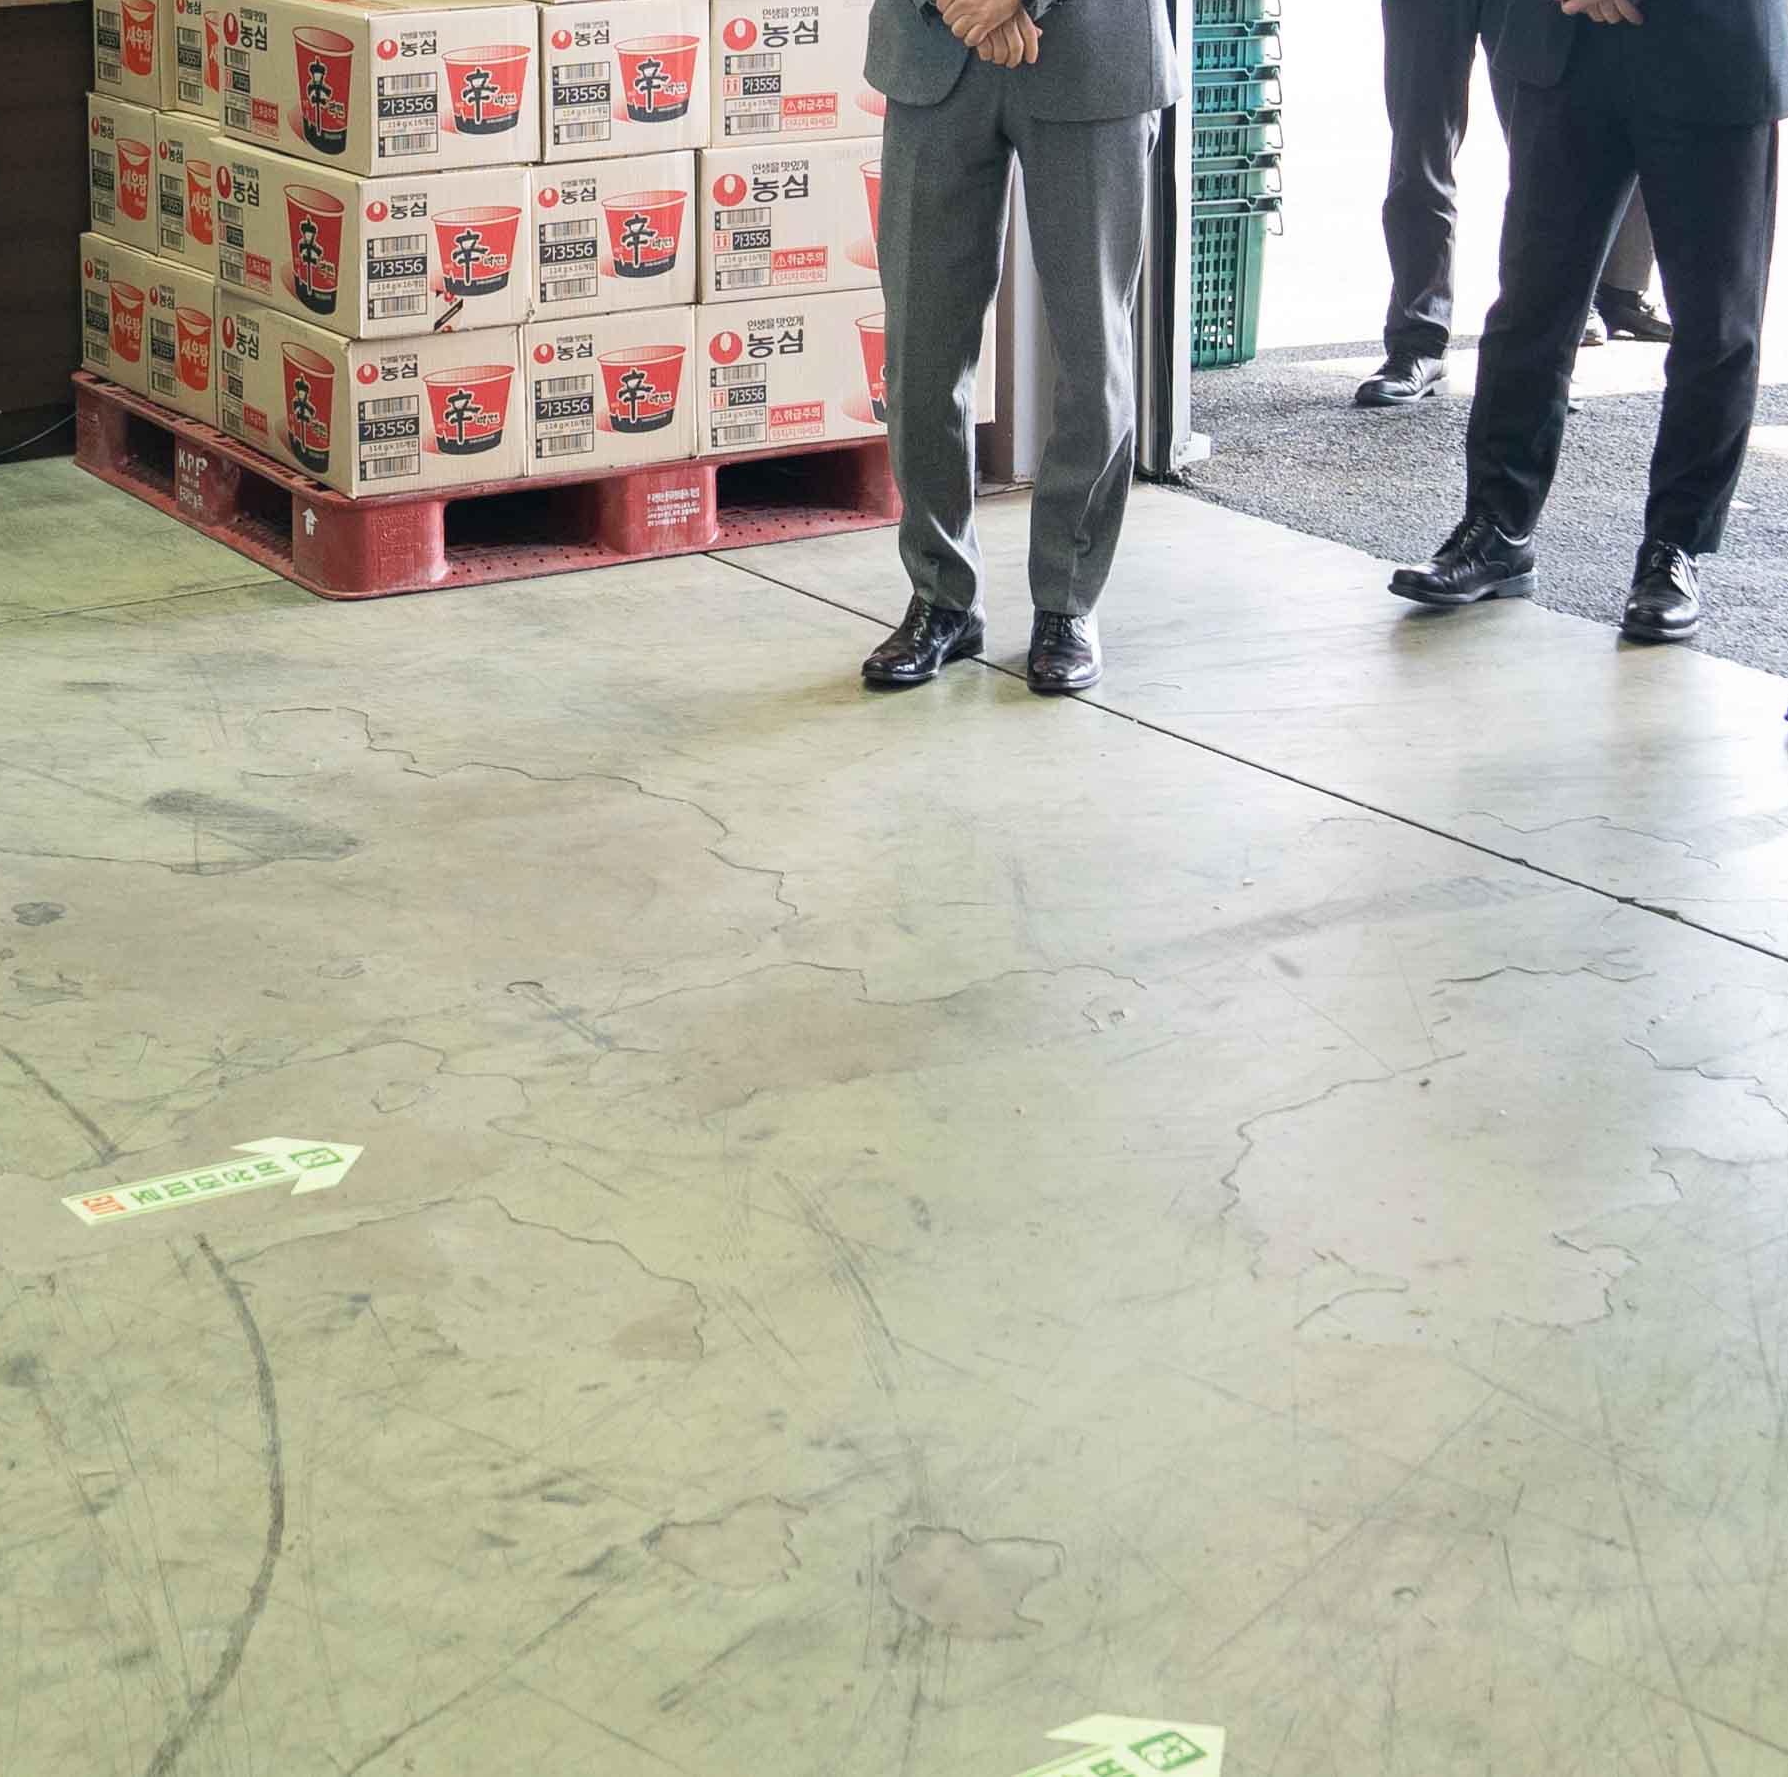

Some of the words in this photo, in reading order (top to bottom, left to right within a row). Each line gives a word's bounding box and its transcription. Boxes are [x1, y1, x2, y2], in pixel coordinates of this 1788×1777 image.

[241, 21, 267, 51] 농심
[575, 30, 609, 46] 농심
[763, 20, 819, 48] 농심
[401, 39, 436, 57] 농심
[557, 86, 606, 102] 가3556
[635, 58, 669, 112] 辛
[745, 77, 779, 92] 가3556
[307, 57, 332, 135] 辛
[463, 68, 498, 123] 辛
[797, 98, 835, 109] 취급주의
[383, 97, 434, 114] 가3556
[233, 175, 259, 206] 농심
[562, 186, 596, 204] 농심
[752, 174, 809, 202] 농심
[391, 202, 427, 219] 농심
[622, 214, 657, 267] 辛
[734, 233, 769, 248] 가3556
[453, 230, 488, 286] 辛
[544, 242, 593, 261] 가3556
[373, 259, 423, 277] 가3556
[235, 327, 259, 360] 농심
[557, 343, 592, 361] 농심
[747, 329, 803, 358] 농심
[381, 362, 417, 381] 농심
[618, 369, 653, 422] 辛
[730, 388, 764, 403] 가3556
[445, 390, 481, 444] 辛
[540, 398, 590, 417] 가3556
[785, 407, 821, 420] 취급주의
[364, 420, 415, 438] 가3556
